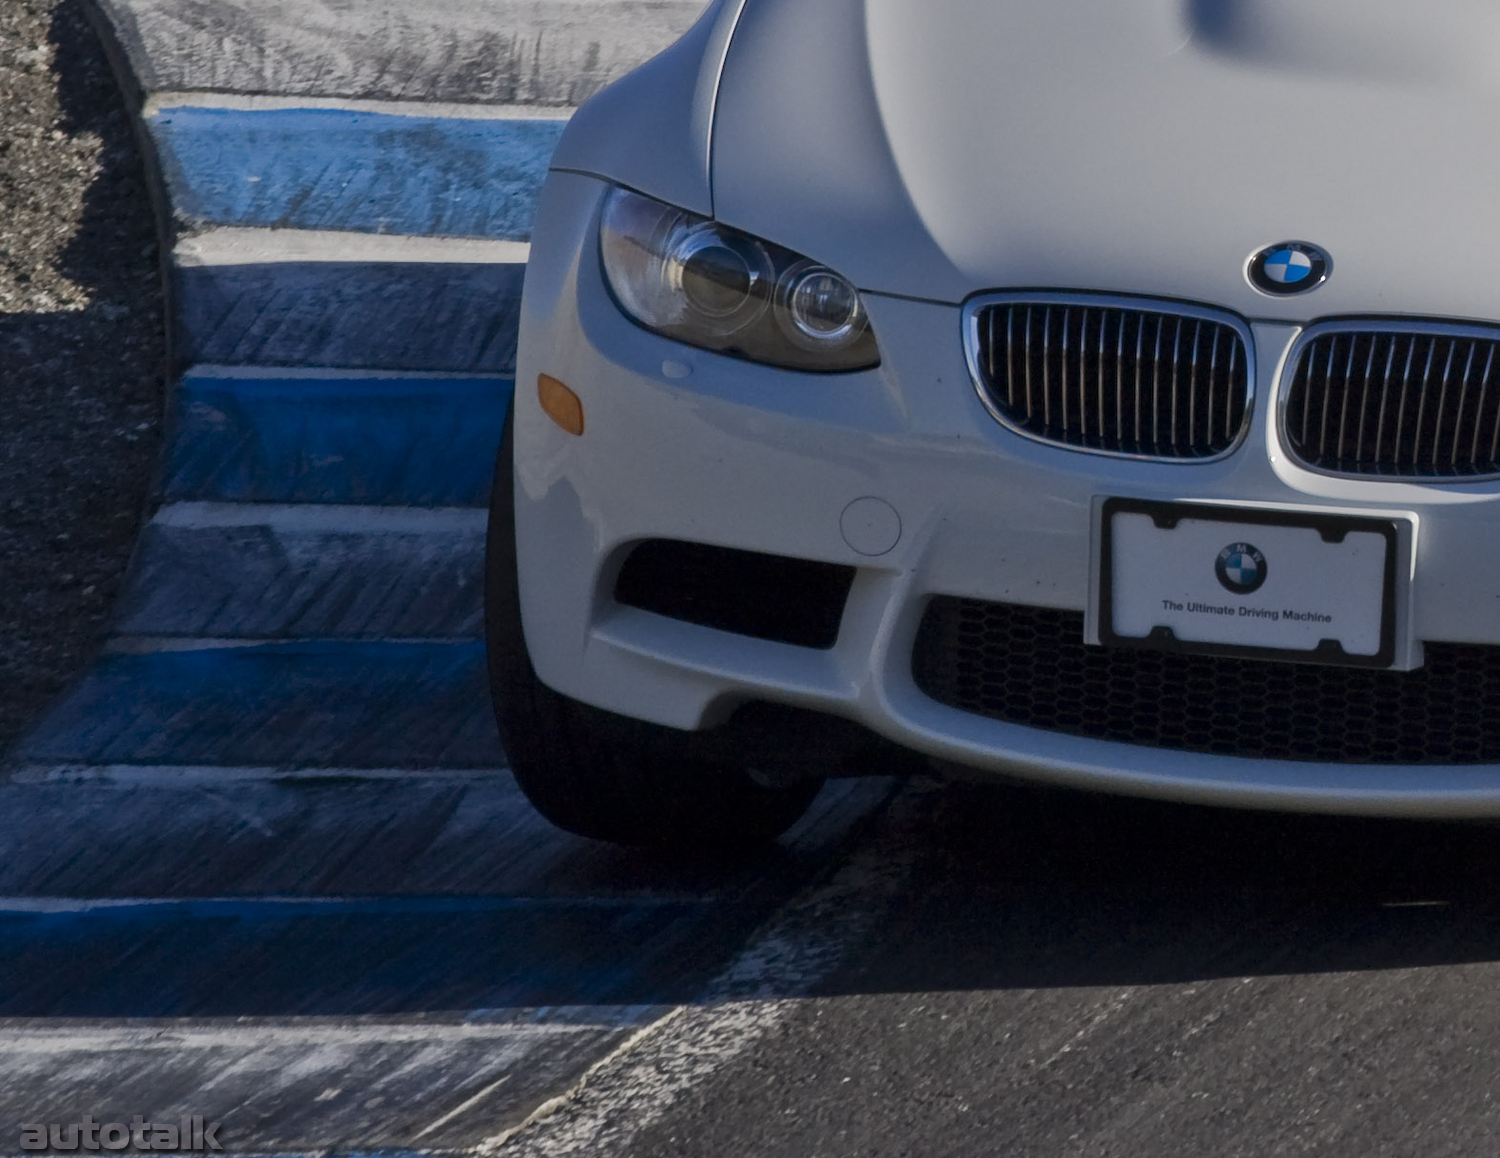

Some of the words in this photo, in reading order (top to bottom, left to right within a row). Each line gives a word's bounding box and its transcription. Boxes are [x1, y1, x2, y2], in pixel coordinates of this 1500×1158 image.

[1162, 600, 1183, 612] The
[1187, 602, 1235, 616] Ultimate
[1238, 606, 1279, 621] Driving
[1283, 610, 1332, 624] Machine
